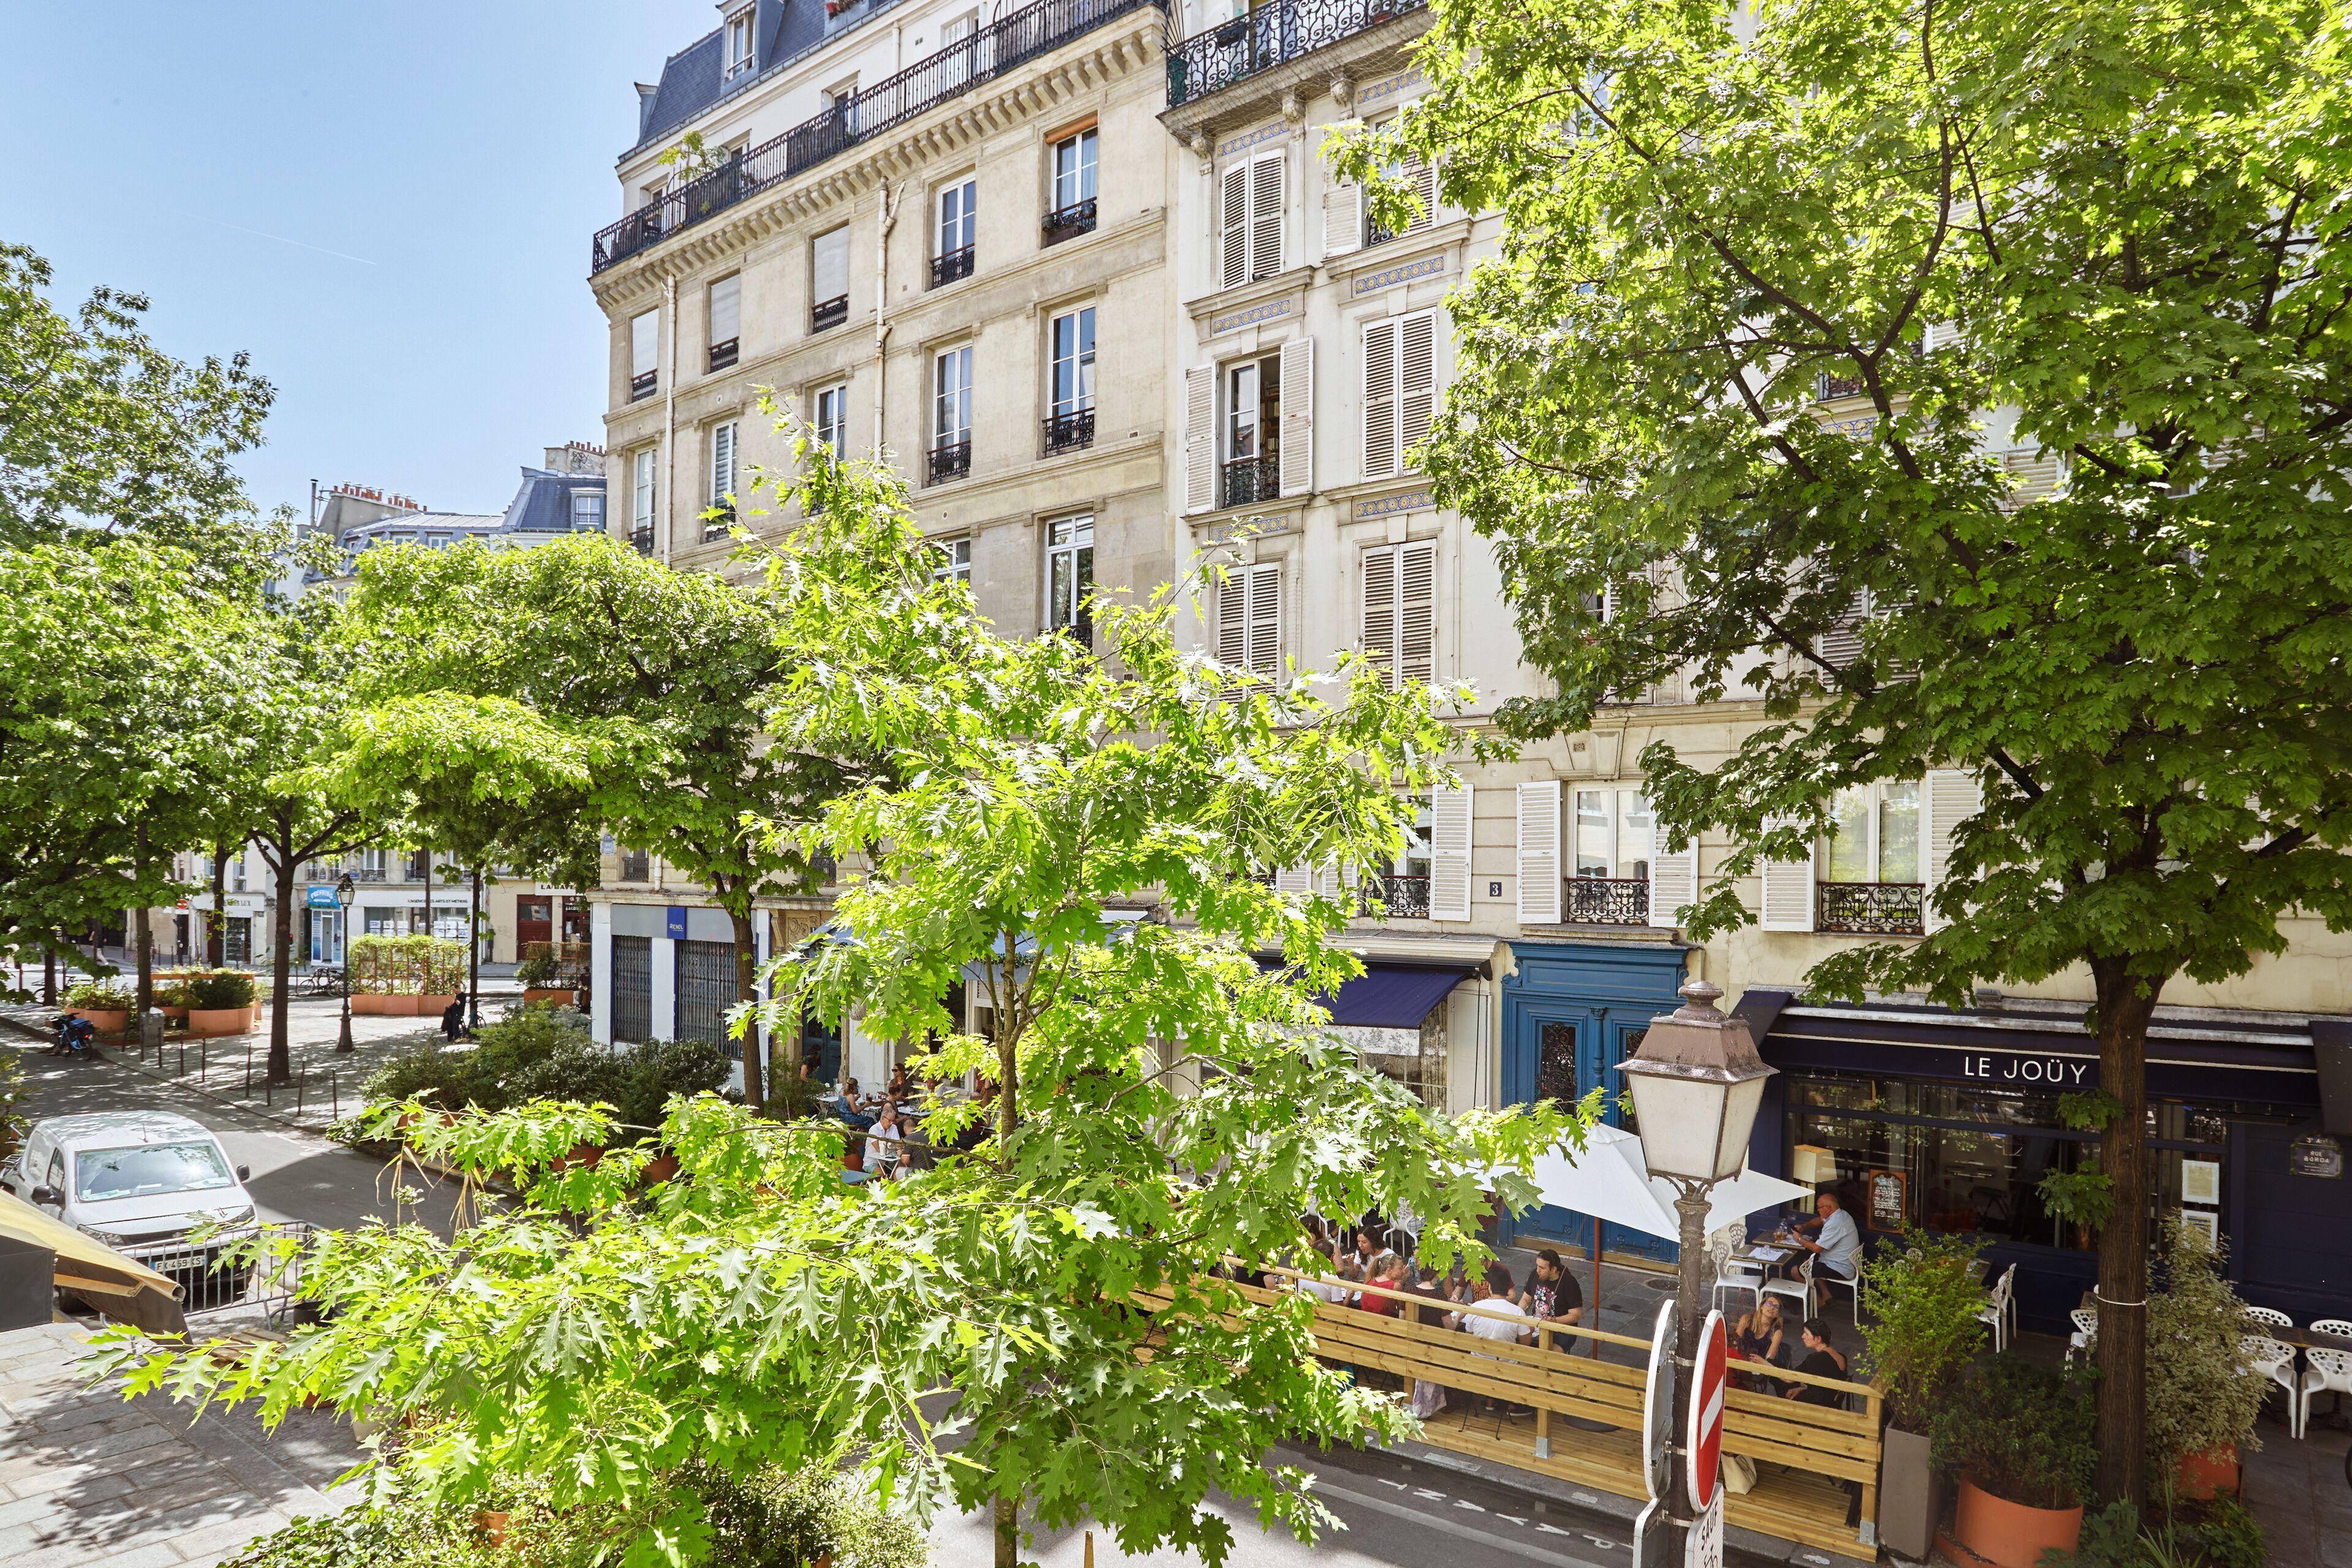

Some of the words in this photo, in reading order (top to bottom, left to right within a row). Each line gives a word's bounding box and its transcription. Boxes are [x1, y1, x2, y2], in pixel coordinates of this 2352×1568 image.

[1492, 884, 1499, 895] 3
[1965, 1056, 1991, 1077] LE
[2003, 1058, 2087, 1084] JOÜY
[1701, 1501, 1718, 1551] SAUF
